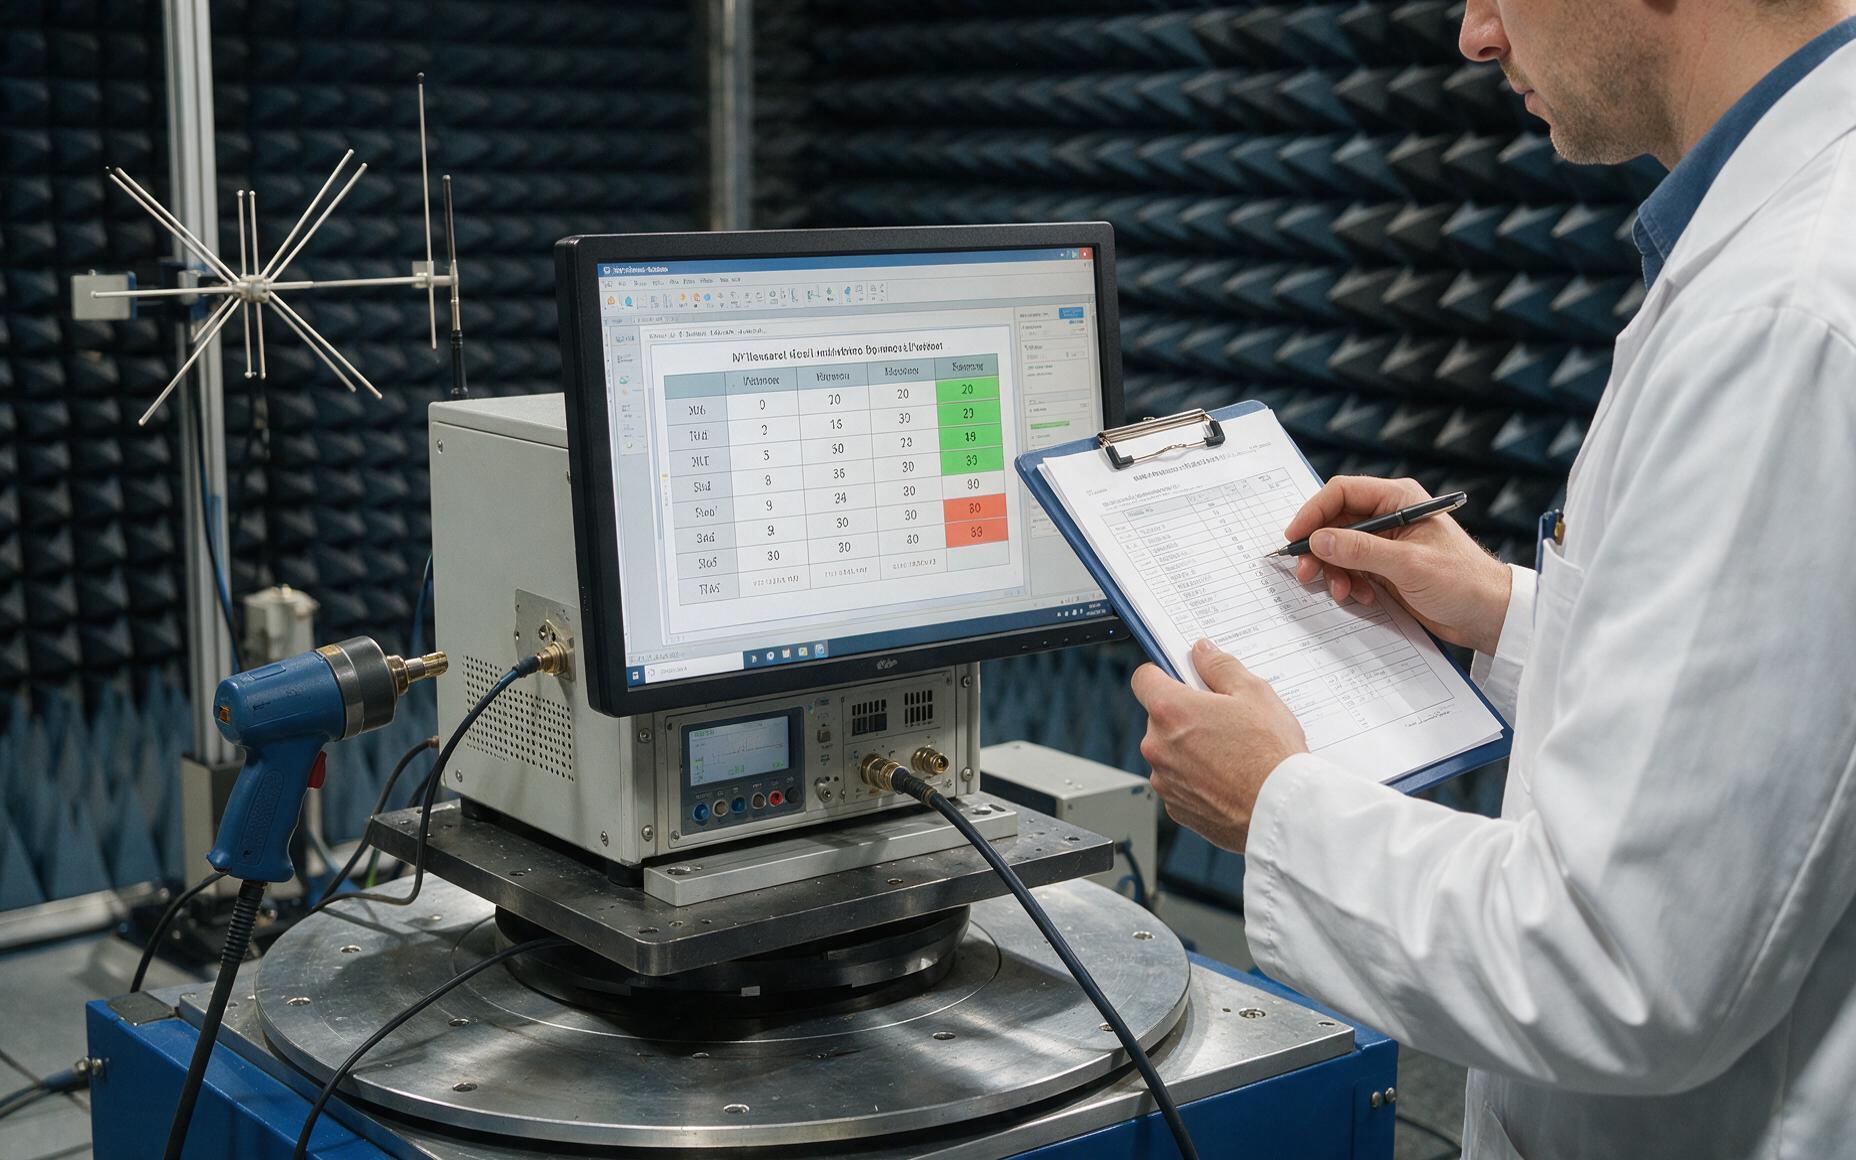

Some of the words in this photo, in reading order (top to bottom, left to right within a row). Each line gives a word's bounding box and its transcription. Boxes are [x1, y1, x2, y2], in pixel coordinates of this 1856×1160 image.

[897, 389, 909, 399] 20
[962, 384, 973, 394] 20
[902, 462, 914, 472] 30
[837, 518, 849, 528] 30
